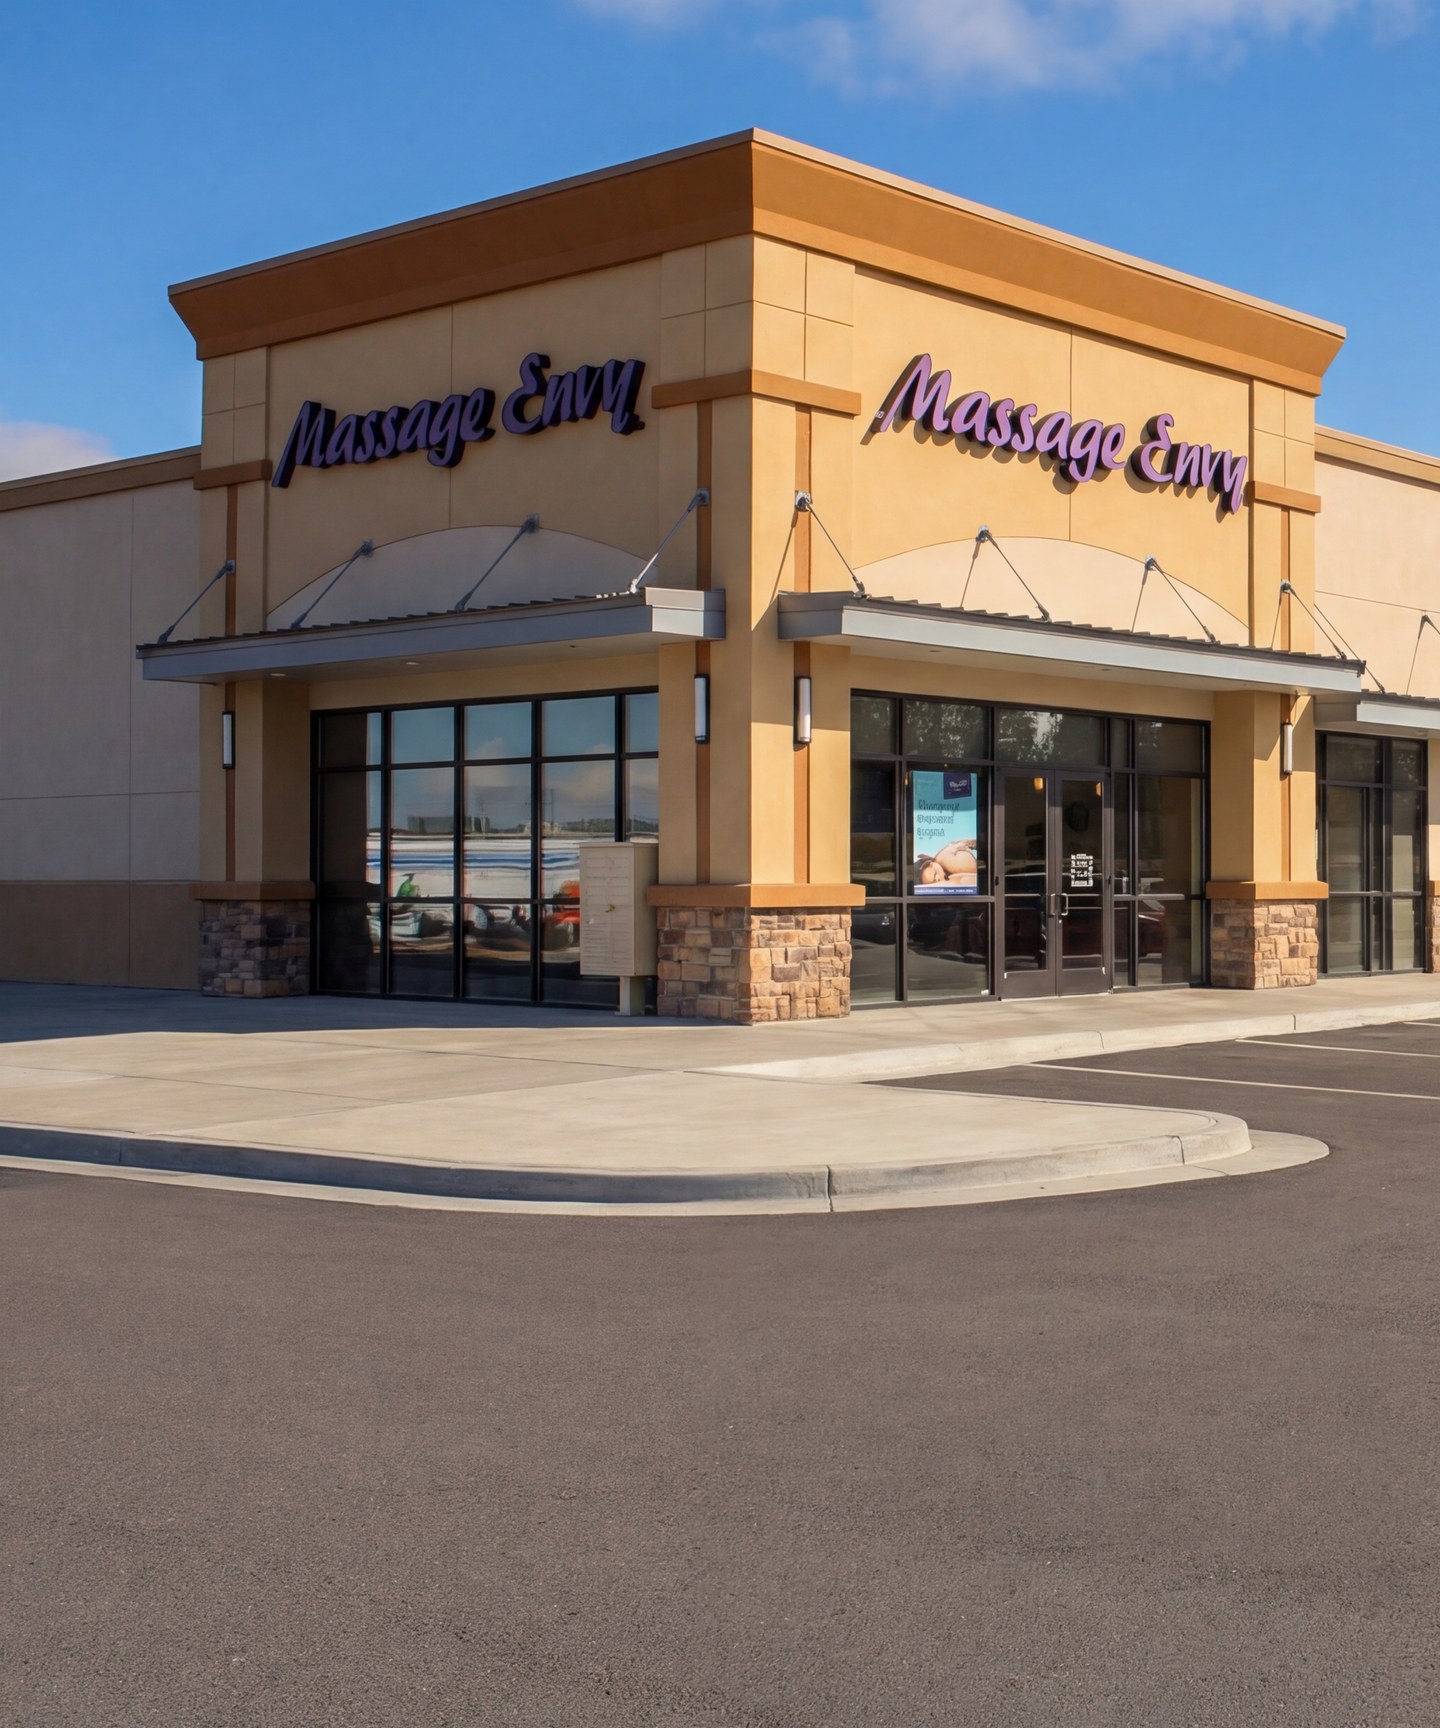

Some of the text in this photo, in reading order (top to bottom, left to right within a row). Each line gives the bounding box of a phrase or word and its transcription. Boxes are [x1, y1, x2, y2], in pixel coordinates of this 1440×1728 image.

[272, 352, 645, 488] Massage Envy
[871, 352, 1248, 515] Massage Envy
